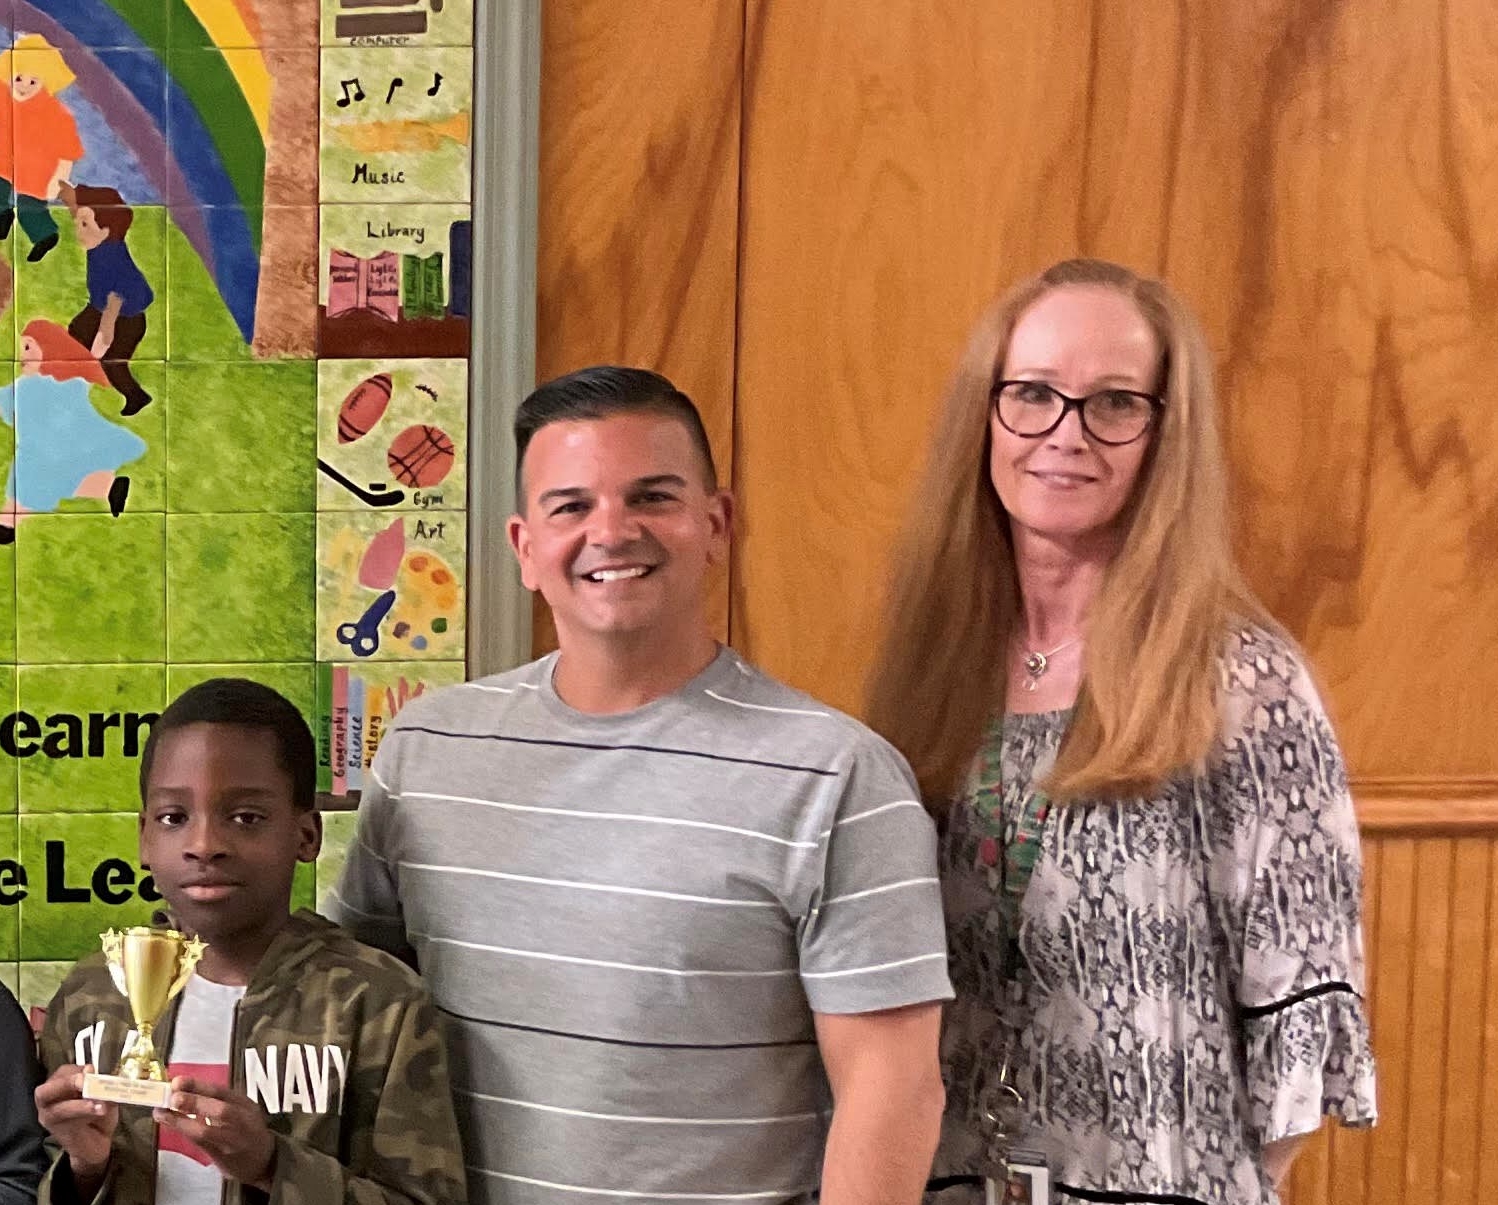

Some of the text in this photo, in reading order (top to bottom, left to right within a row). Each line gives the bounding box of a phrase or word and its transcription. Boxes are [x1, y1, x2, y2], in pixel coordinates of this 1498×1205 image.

[351, 163, 406, 184] Music
[367, 221, 425, 244] Library
[413, 490, 444, 509] Gym
[414, 519, 446, 540] Art
[333, 706, 349, 778] Geography
[349, 716, 362, 769] Science
[245, 1043, 351, 1116] NAVY
